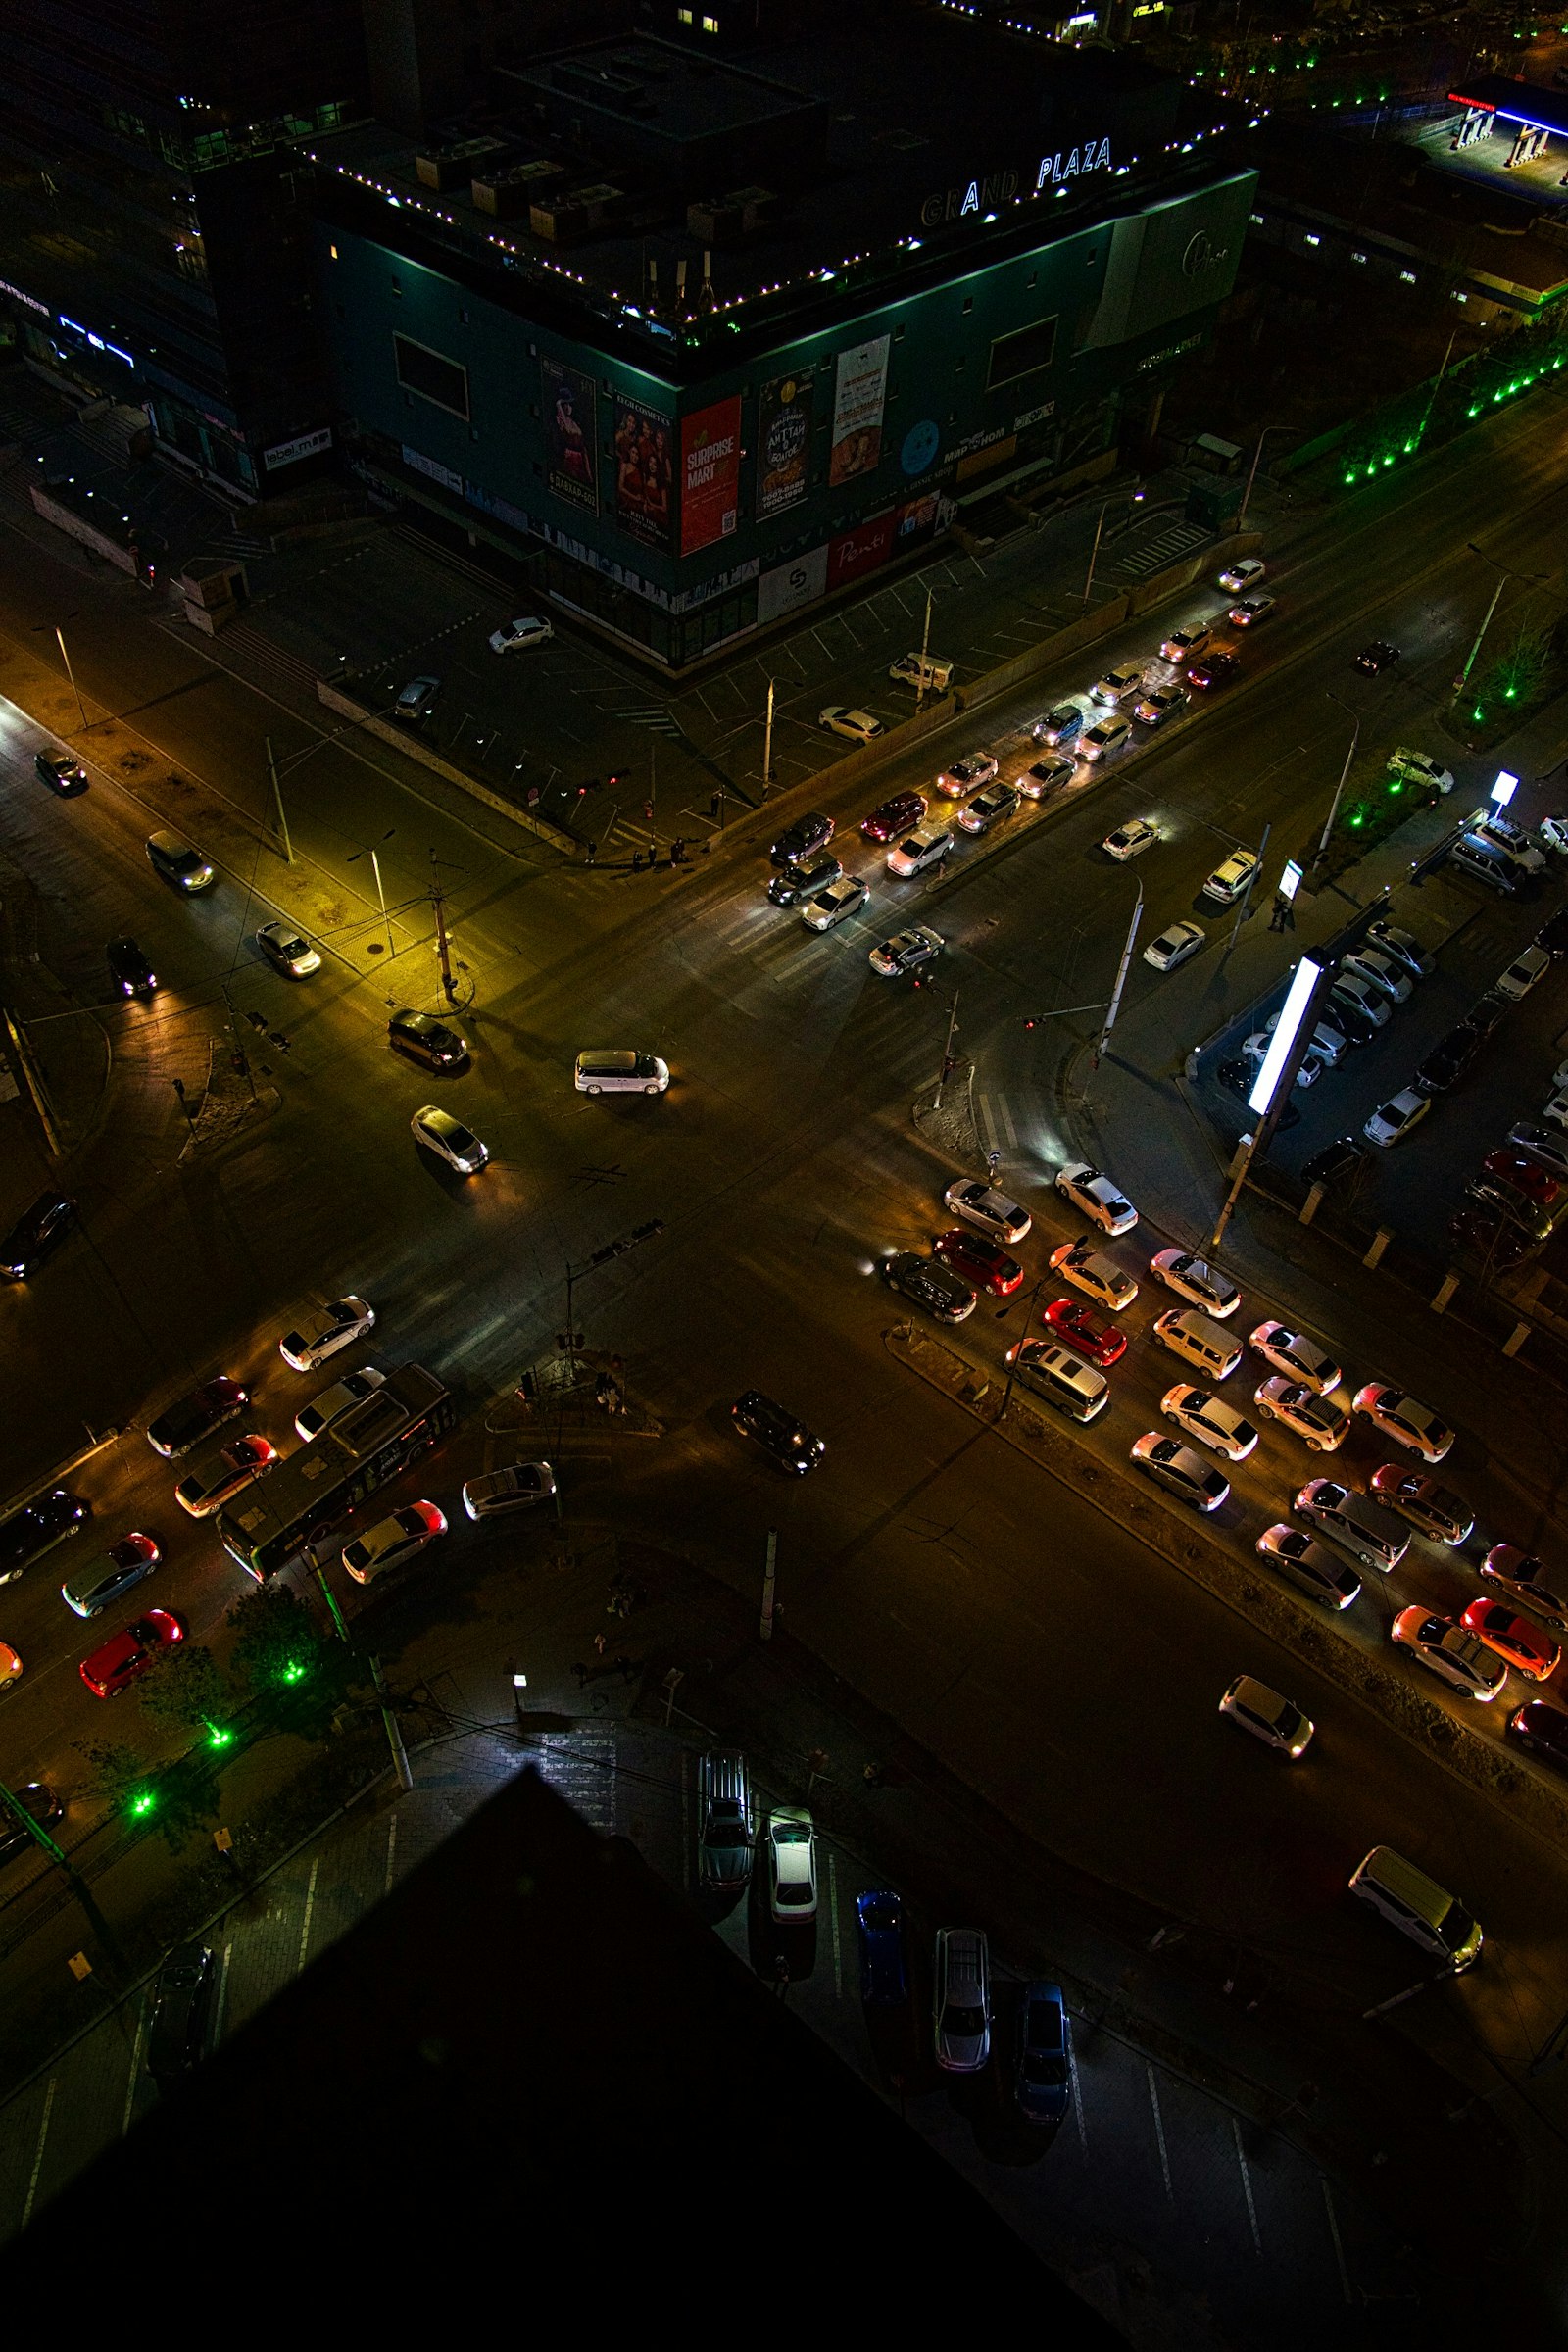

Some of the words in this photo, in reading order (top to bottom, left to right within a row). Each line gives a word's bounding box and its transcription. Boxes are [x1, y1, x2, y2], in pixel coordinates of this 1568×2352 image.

[920, 170, 1019, 226] GRAND
[1037, 136, 1110, 189] PLAZA
[635, 403, 671, 427] COSMETICS
[687, 435, 734, 471] SURPRISE
[687, 462, 716, 490] MART
[837, 533, 884, 568] Penti
